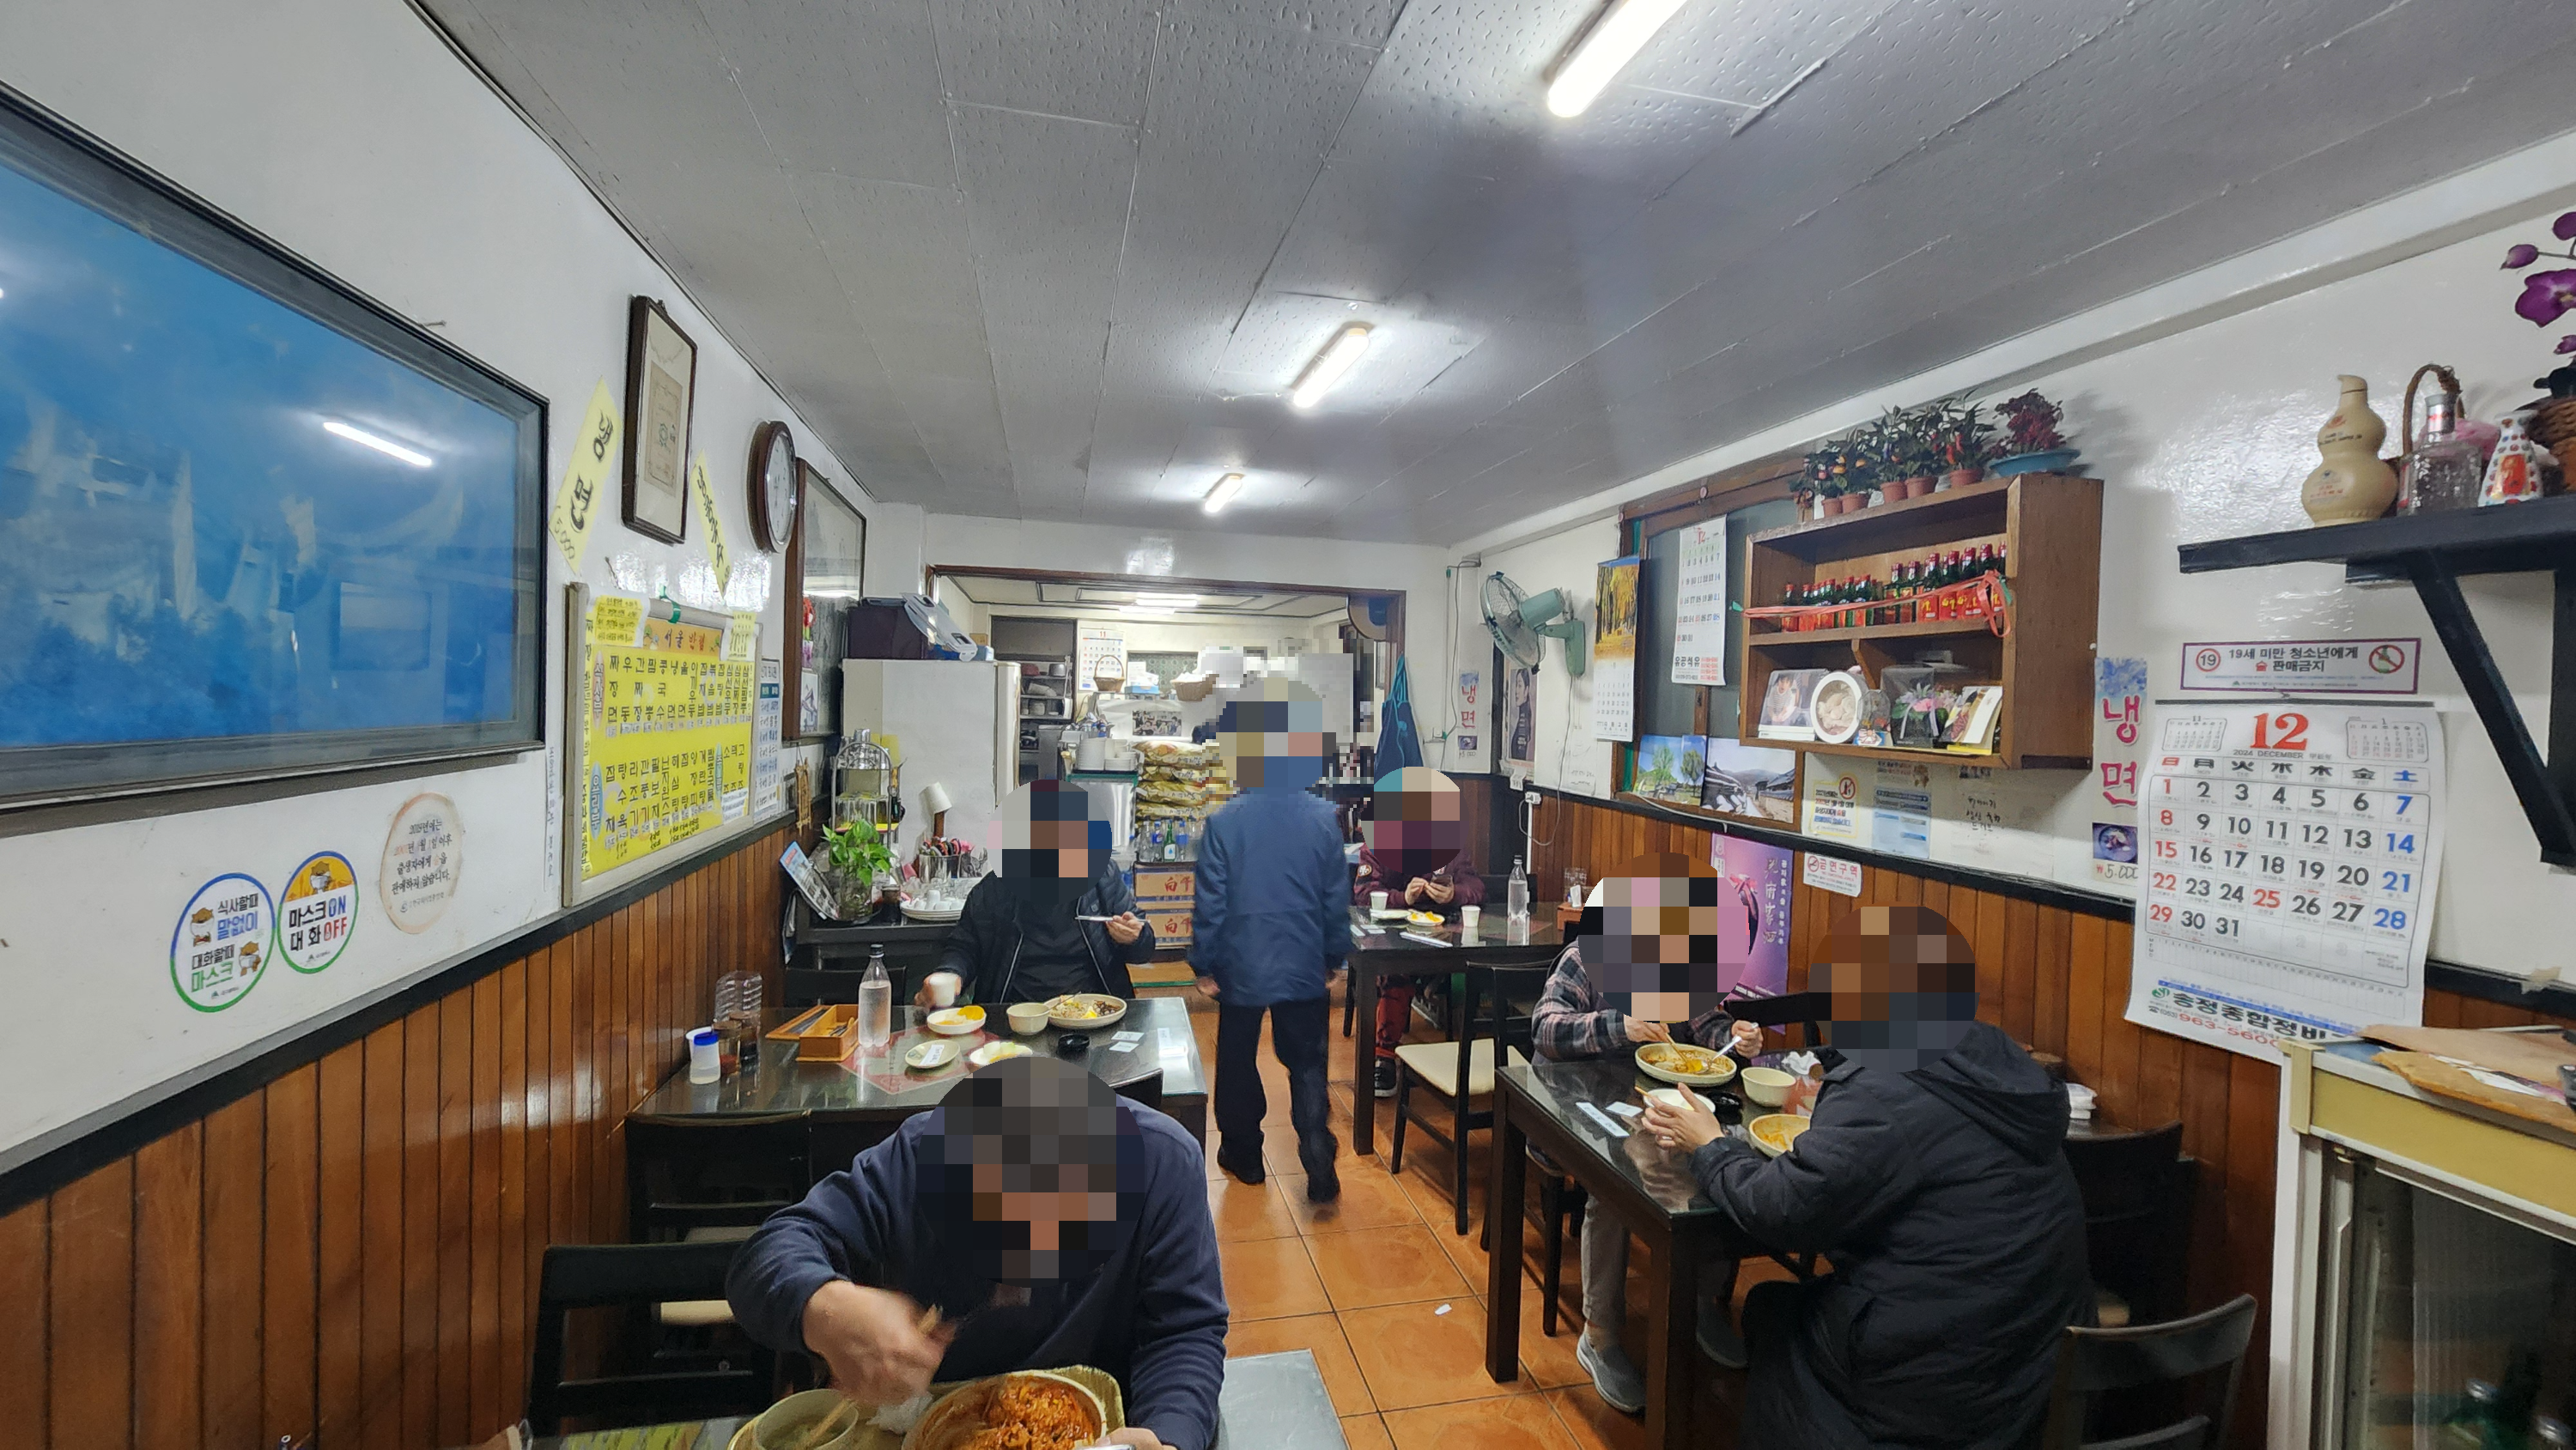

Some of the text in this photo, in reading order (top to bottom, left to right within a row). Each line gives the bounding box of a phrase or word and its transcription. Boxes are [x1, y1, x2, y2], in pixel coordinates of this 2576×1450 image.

[665, 628, 684, 650] 서울
[2201, 654, 2216, 666] 19
[2229, 646, 2359, 659] 19세 미만 청소년에게
[2256, 659, 2325, 672] 술 판매금지
[608, 655, 619, 723] 짜장면
[621, 656, 632, 722] 우동
[634, 657, 645, 721] 간짜장
[645, 658, 656, 721] 짬뽕
[657, 659, 667, 720] 콩국수
[678, 661, 689, 719] 울면
[1461, 684, 1476, 729] 냉면
[2100, 695, 2140, 808] 냉면
[2250, 713, 2308, 750] 12
[2232, 760, 2253, 771] 火
[2353, 767, 2376, 780] 金
[2394, 769, 2418, 782] 土
[2257, 750, 2303, 759] DECEMBER
[605, 765, 616, 833] 잡채
[617, 762, 628, 829] 탕수육
[629, 761, 639, 827] 라조기
[641, 759, 650, 823] 깐풍기
[651, 756, 659, 818] 팔보채
[2164, 779, 2414, 815] 1 2 3 4 5 6 7
[2160, 810, 2415, 854] 8 9 10 11 12 13 14
[1820, 858, 1857, 878] 금연구역
[2155, 840, 2410, 893] 15 16 17 18 19 20 21
[217, 892, 259, 915] 식사할때
[289, 895, 347, 929] 마스크 ON
[2149, 904, 2172, 923] 29
[2181, 910, 2205, 930] 30
[2215, 917, 2239, 937] 31
[2153, 871, 2406, 930] 22 23 24 25 26 27 28
[217, 911, 258, 941] 말없이
[324, 916, 348, 942] OFF
[191, 943, 235, 971] 대화할때
[191, 962, 234, 993] 마스크
[2172, 992, 2345, 1040] 송정종합정비
